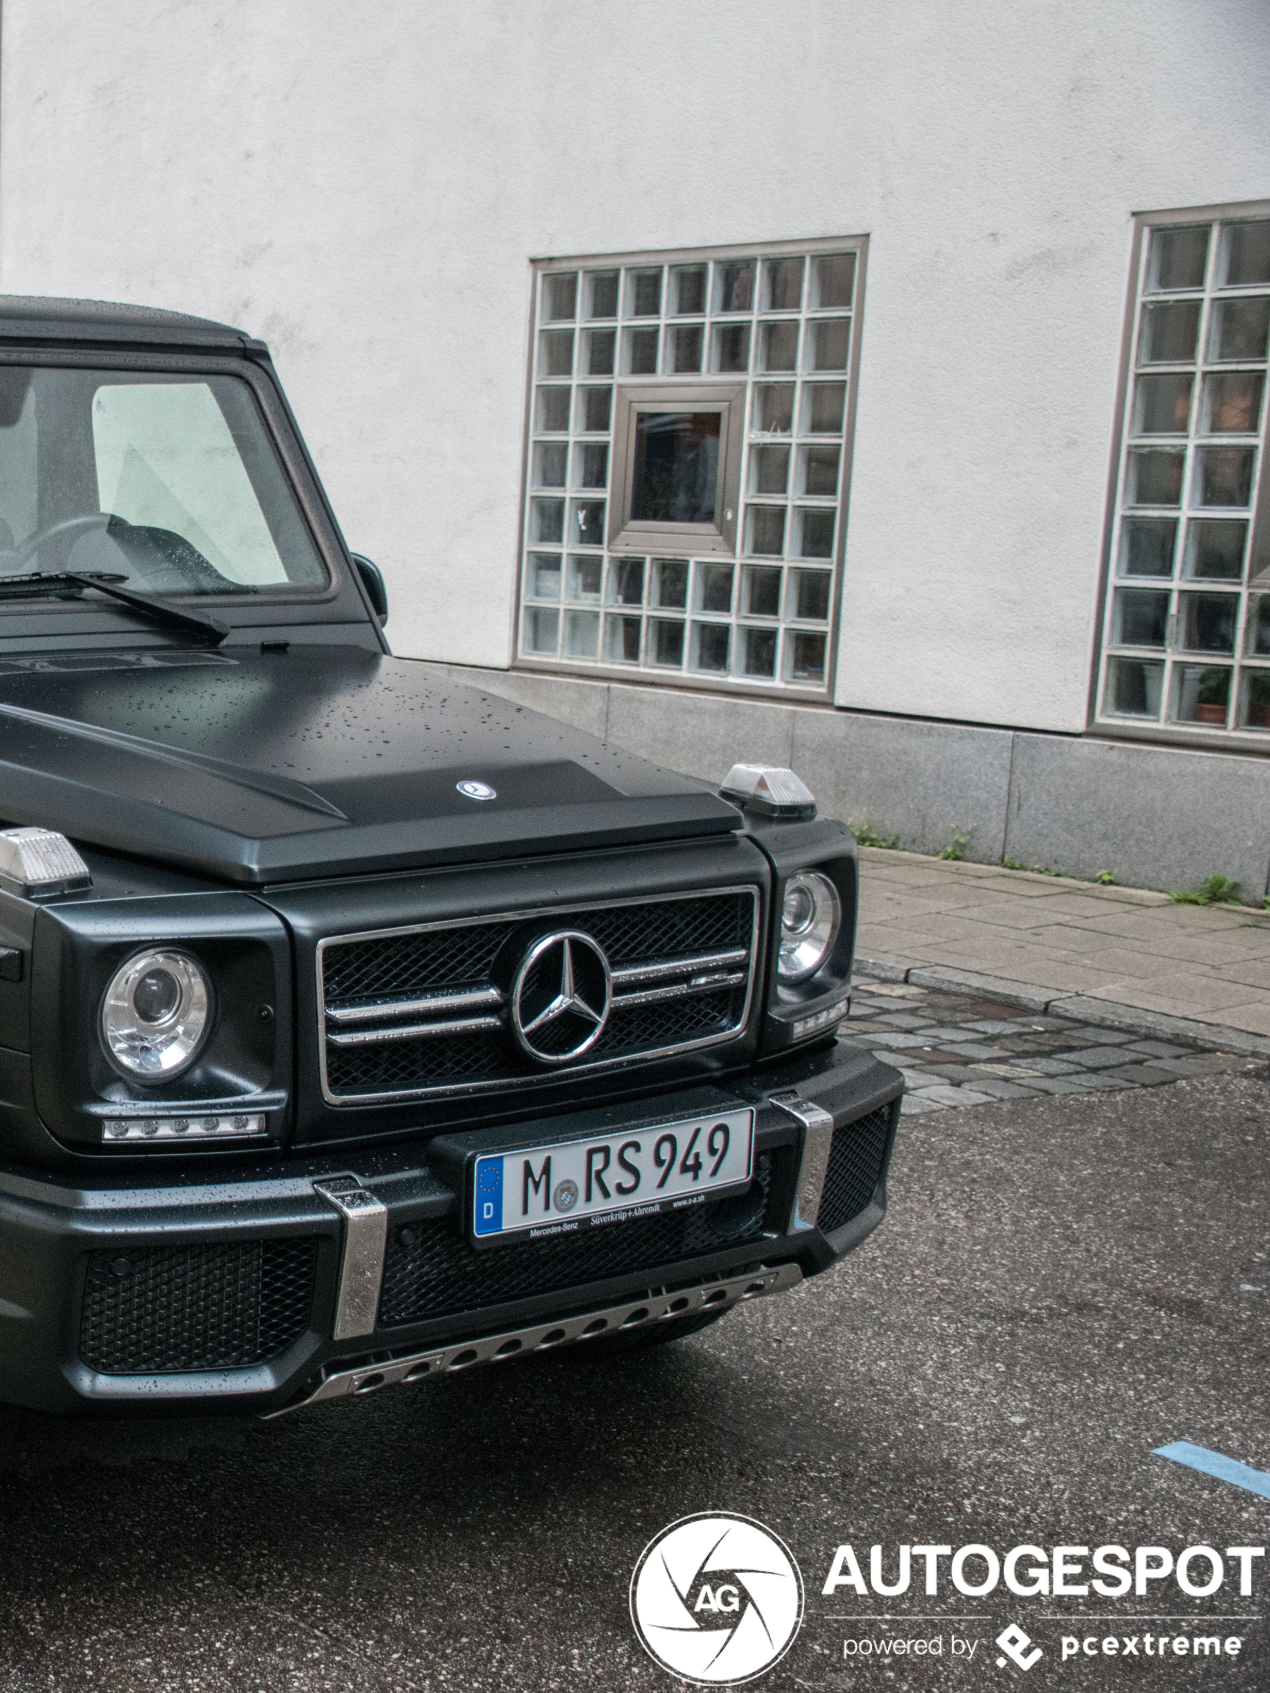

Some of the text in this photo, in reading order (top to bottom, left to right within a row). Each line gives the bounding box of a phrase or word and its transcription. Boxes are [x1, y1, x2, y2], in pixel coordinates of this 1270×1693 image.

[522, 1155, 552, 1215] M
[585, 1140, 641, 1203] RS
[653, 1122, 730, 1189] 949
[483, 1202, 494, 1220] D
[530, 1222, 578, 1238] Mercedes-Benz
